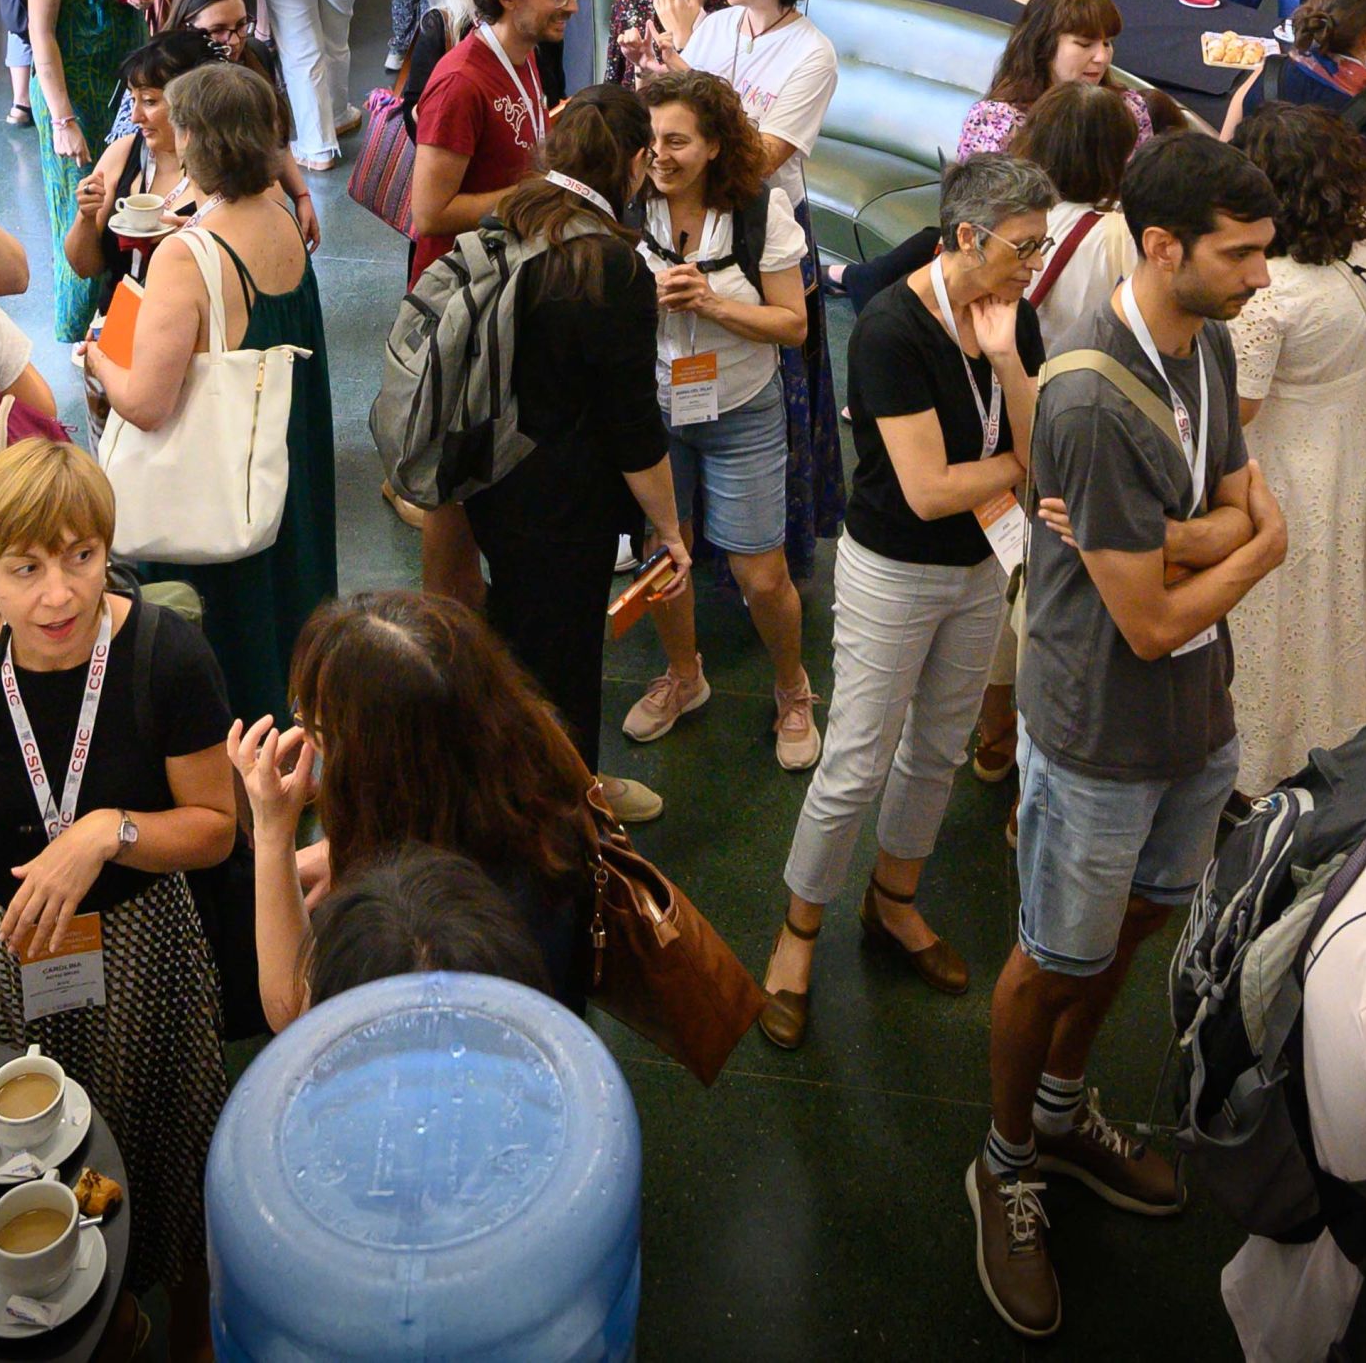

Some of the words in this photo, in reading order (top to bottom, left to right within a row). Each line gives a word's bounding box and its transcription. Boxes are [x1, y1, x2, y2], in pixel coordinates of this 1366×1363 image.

[563, 178, 591, 197] CSIC
[987, 412, 998, 446] CSIC
[1176, 406, 1191, 443] CSIC
[3, 662, 20, 707] CSIC
[89, 644, 108, 691] CSIC
[23, 742, 45, 787] CSIC
[72, 728, 90, 773] CSIC
